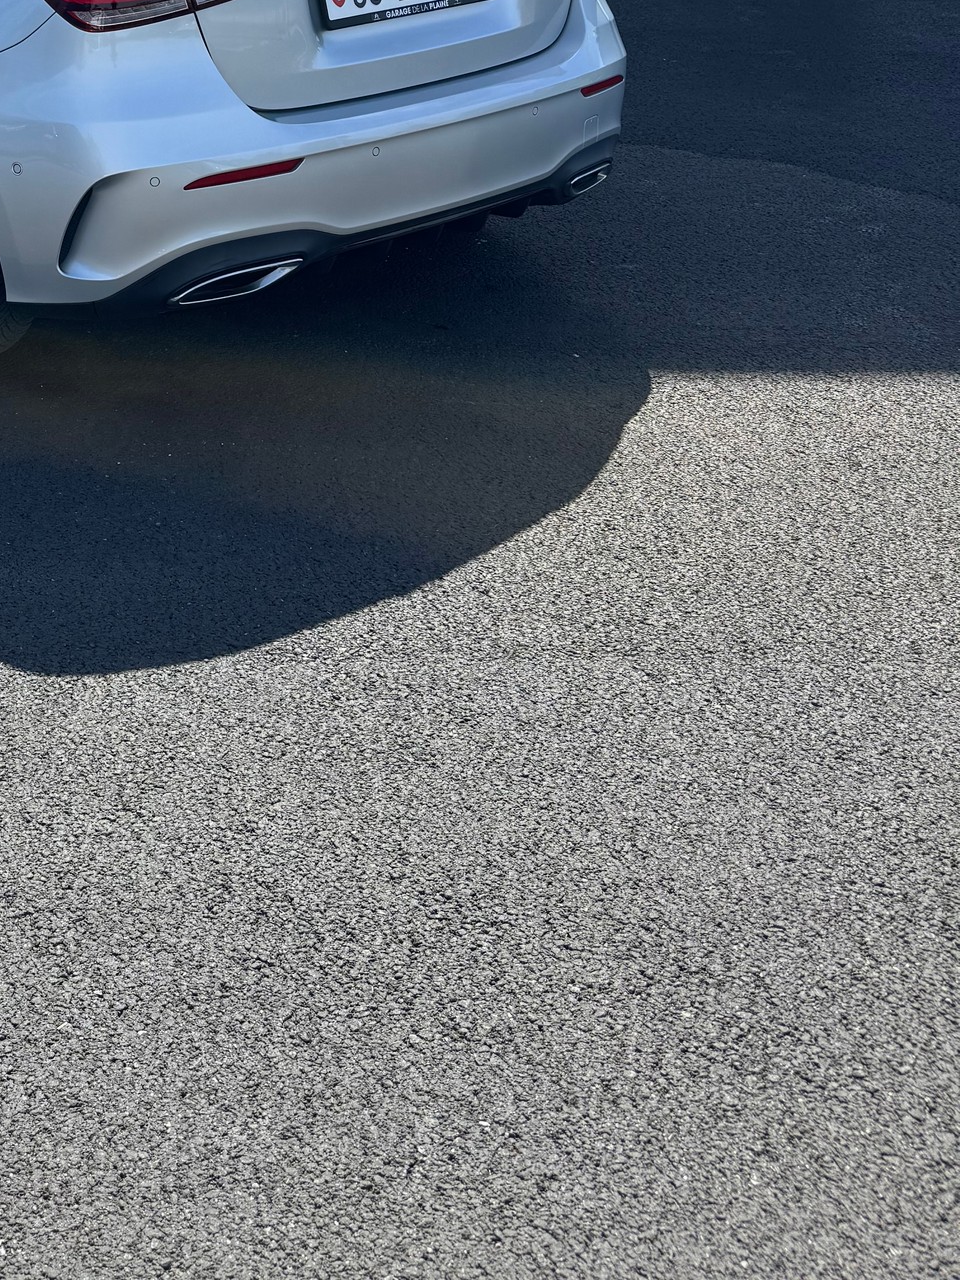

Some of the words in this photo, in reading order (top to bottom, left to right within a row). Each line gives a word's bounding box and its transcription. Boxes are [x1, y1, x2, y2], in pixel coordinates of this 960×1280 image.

[385, 6, 411, 19] GARAGE
[412, 5, 420, 14] DE
[420, 3, 429, 12] LA
[429, 0, 449, 10] PLAINE
